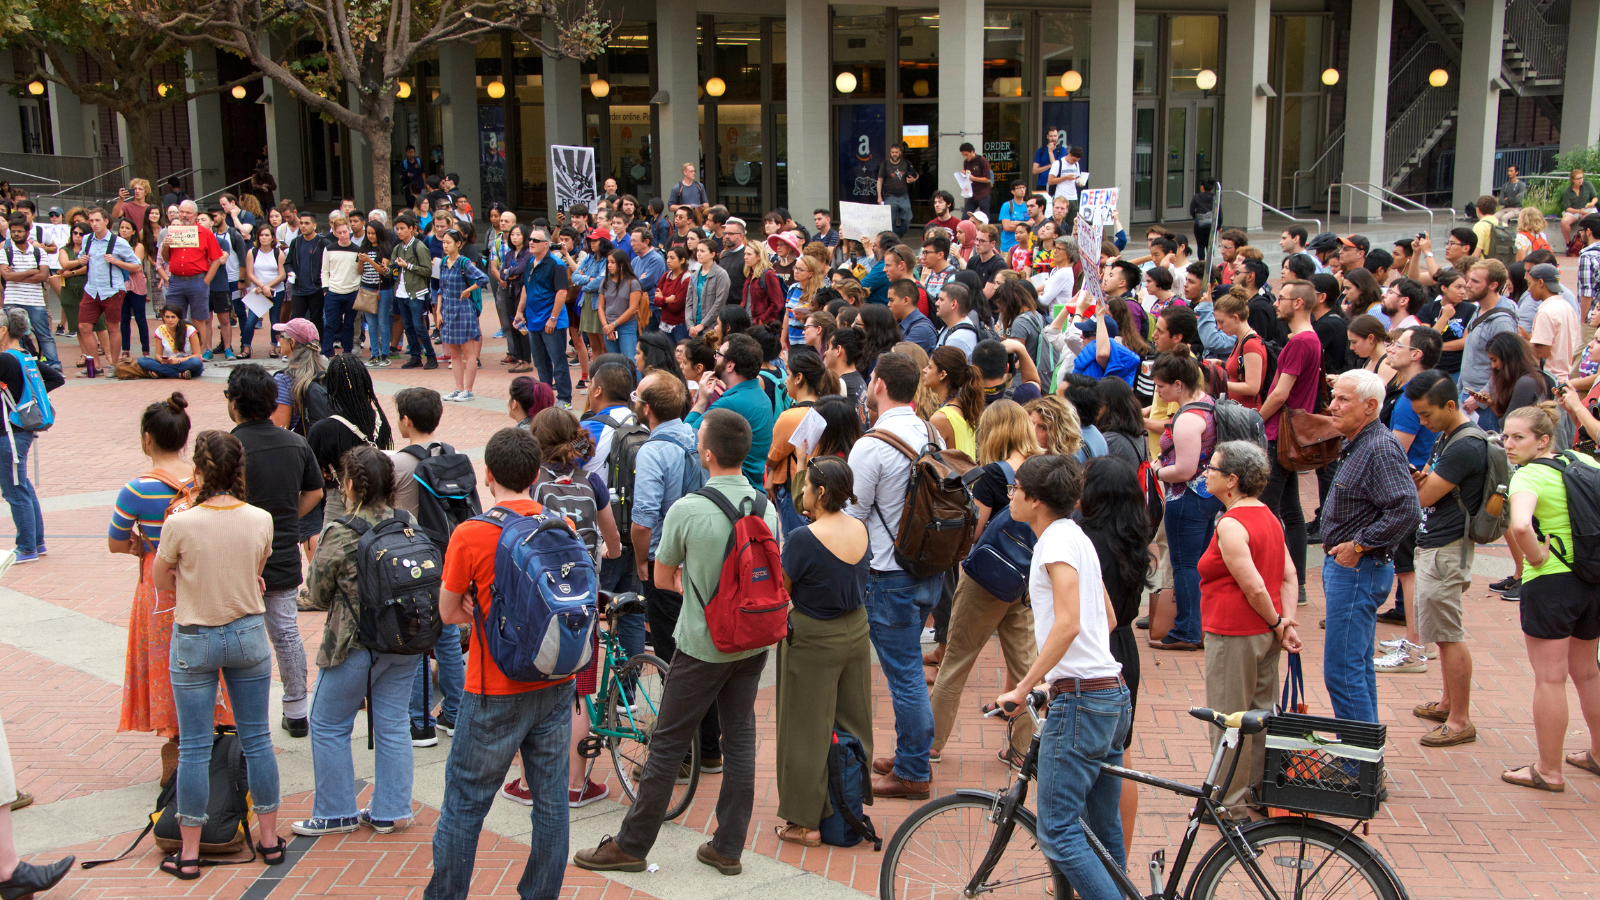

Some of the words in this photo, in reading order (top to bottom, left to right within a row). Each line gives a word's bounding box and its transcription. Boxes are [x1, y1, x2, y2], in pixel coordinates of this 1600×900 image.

[610, 112, 622, 121] rder
[858, 134, 871, 156] a
[984, 141, 1011, 151] ORDER
[990, 162, 1000, 171] CK
[1001, 162, 1013, 171] UP
[993, 172, 1008, 182] ERE.
[1081, 190, 1117, 206] DEFEND
[1083, 205, 1114, 222] DCA
